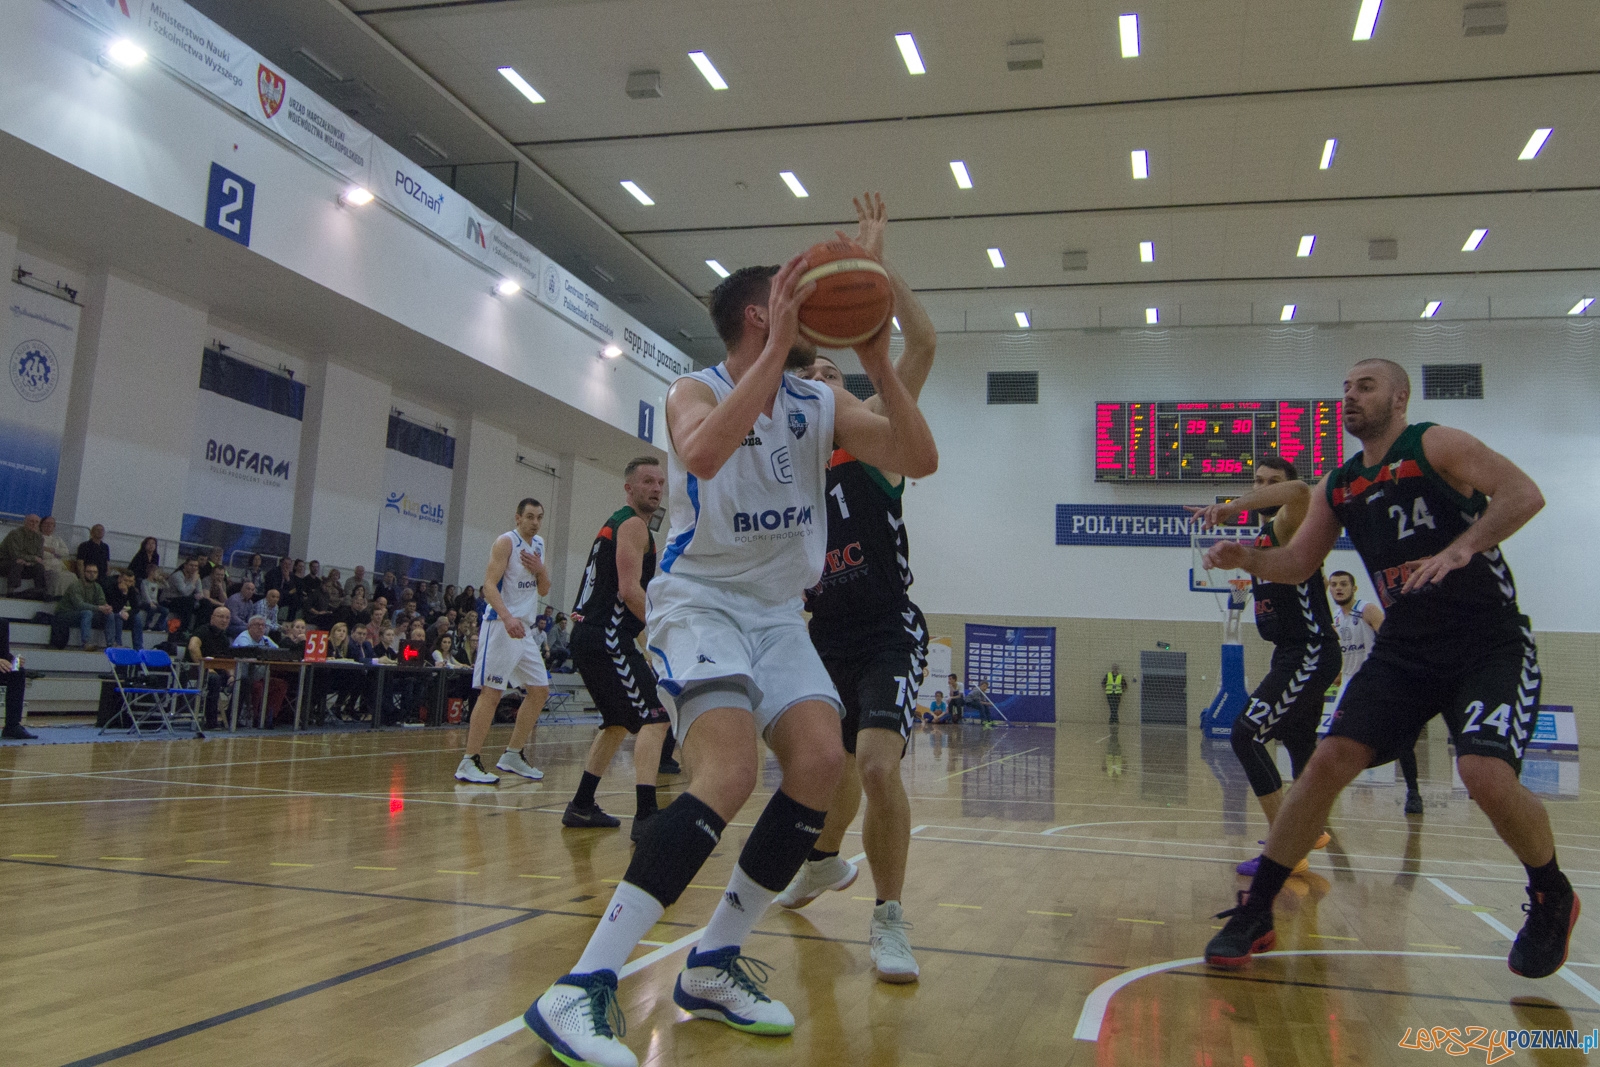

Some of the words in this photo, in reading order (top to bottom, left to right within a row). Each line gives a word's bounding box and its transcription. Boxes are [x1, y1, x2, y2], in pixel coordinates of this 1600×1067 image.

[150, 2, 205, 46] Ministerstwo
[206, 39, 230, 63] Nauki
[153, 20, 203, 61] Szkolnictwa
[218, 178, 244, 234] 2
[564, 279, 585, 301] Centrum
[644, 407, 650, 438] 1
[1186, 420, 1206, 434] 39
[1214, 426, 1220, 434] 3
[1232, 420, 1252, 434] 30
[1172, 441, 1179, 449] 2
[205, 438, 290, 480] BIOFARM
[1237, 509, 1249, 525] 3
[1388, 496, 1437, 540] 24
[734, 533, 767, 543] POLSKI
[307, 636, 327, 654] 55
[1245, 697, 1271, 726] 12
[1461, 700, 1511, 737] 24
